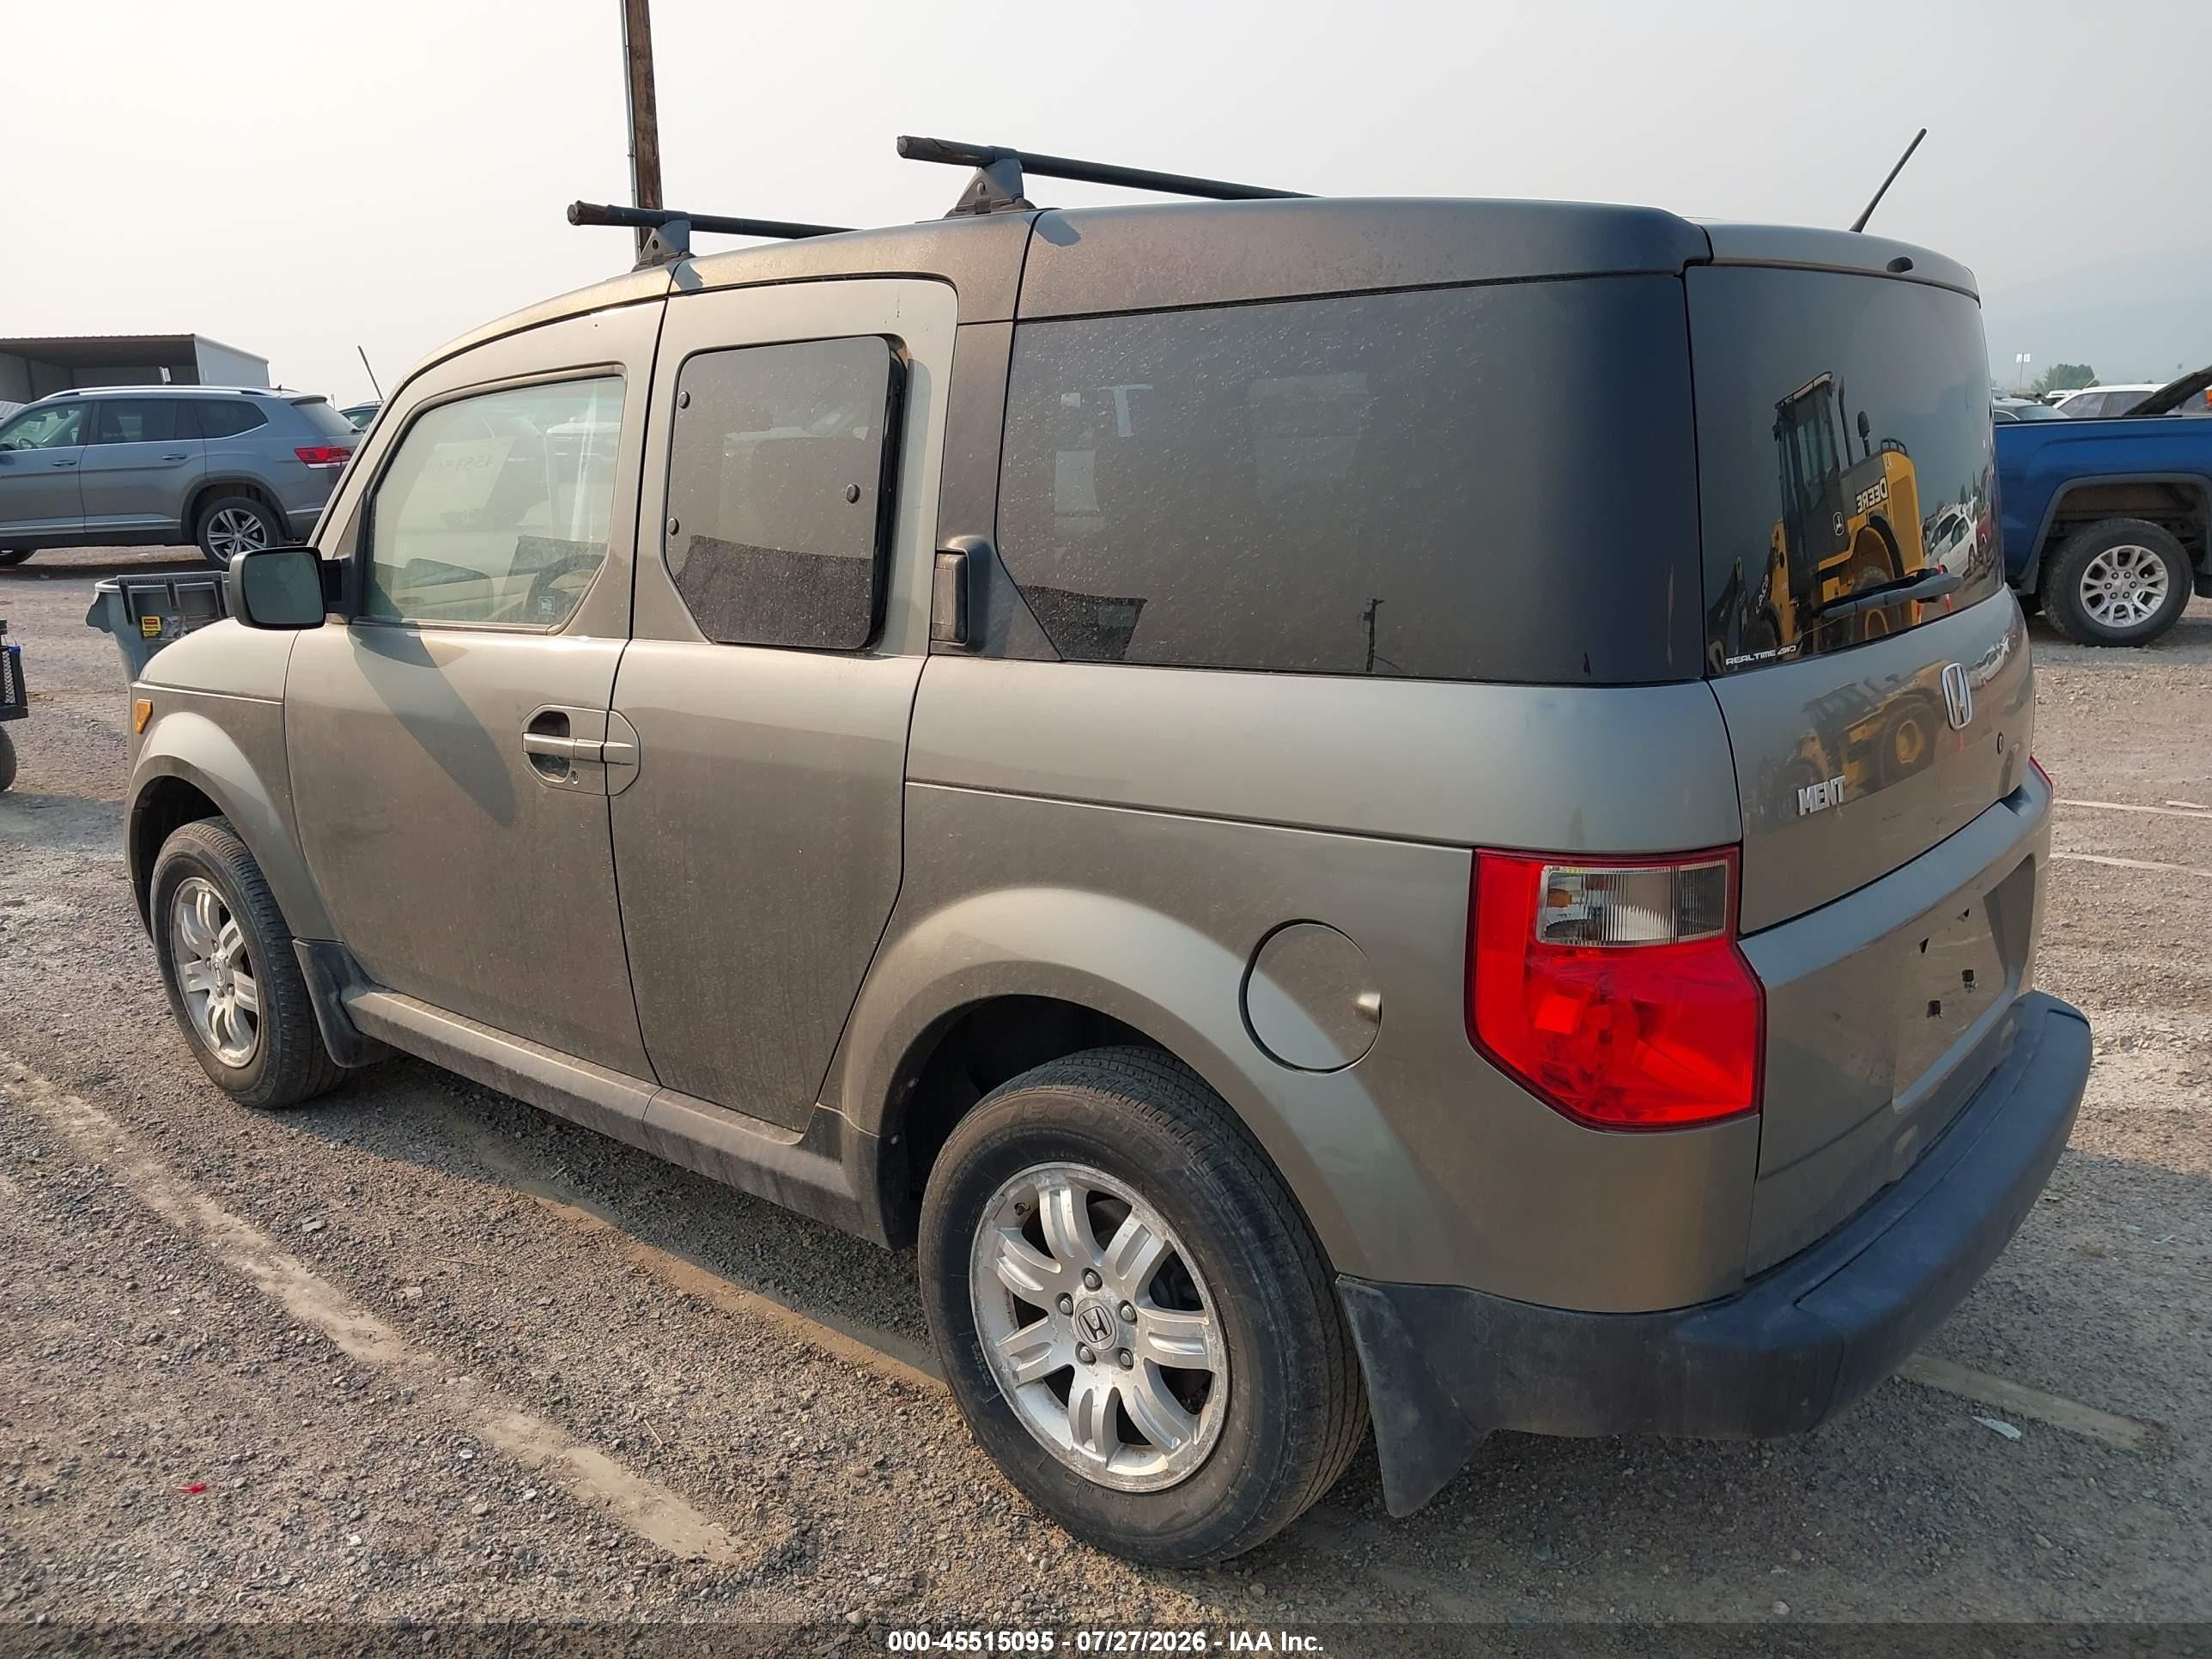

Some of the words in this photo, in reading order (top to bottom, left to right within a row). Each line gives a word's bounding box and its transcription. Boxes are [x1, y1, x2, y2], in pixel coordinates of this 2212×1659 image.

[1725, 649, 1776, 665] REALTIME
[1778, 645, 1796, 655] 4WD
[1797, 775, 1846, 816] MENT
